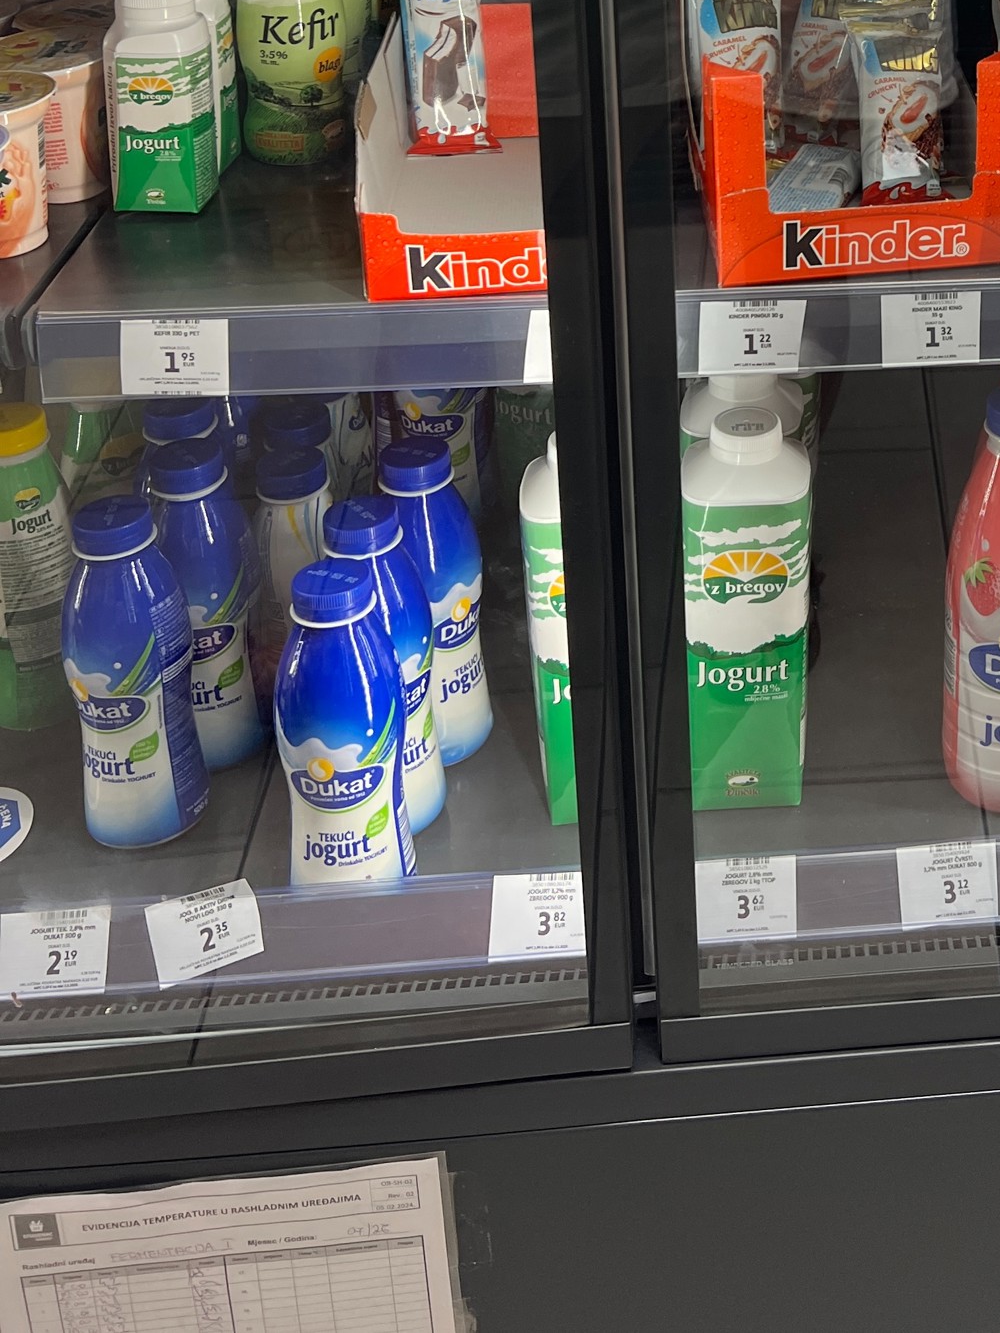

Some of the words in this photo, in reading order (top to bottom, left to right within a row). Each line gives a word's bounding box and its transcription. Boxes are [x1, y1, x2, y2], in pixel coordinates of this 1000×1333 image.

[259, 7, 339, 50] Kefir
[713, 35, 748, 48] CARAMEL
[259, 50, 288, 60] 3,5%
[867, 83, 898, 99] CRUNCHY
[125, 135, 180, 153] Jogurt
[782, 221, 966, 269] Kinder
[759, 334, 771, 343] 22
[940, 326, 952, 336] 32
[181, 352, 195, 361] 95
[11, 509, 52, 535] Jogurt
[725, 581, 785, 598] bregov
[697, 659, 789, 692] Jogurt
[753, 684, 781, 694] 2,8%
[88, 745, 116, 761] TEKUĆI
[300, 773, 373, 796] Dukat
[318, 831, 355, 843] TEKUĆI
[304, 833, 372, 866] jogurt
[957, 879, 969, 889] 12
[737, 895, 750, 919] 3
[752, 895, 765, 905] 62
[215, 921, 229, 932] 35
[538, 912, 550, 935] 3
[554, 912, 566, 922] 82
[64, 950, 78, 960] 19
[765, 958, 794, 967] GLASS
[82, 1219, 141, 1233] EVIDENCIJA
[143, 1207, 218, 1226] TEMPERATURE
[220, 1206, 229, 1216] U
[231, 1202, 299, 1215] RASHLADNIM
[301, 1193, 361, 1208] UREĐAJIMA
[22, 1259, 65, 1271] Rashladni
